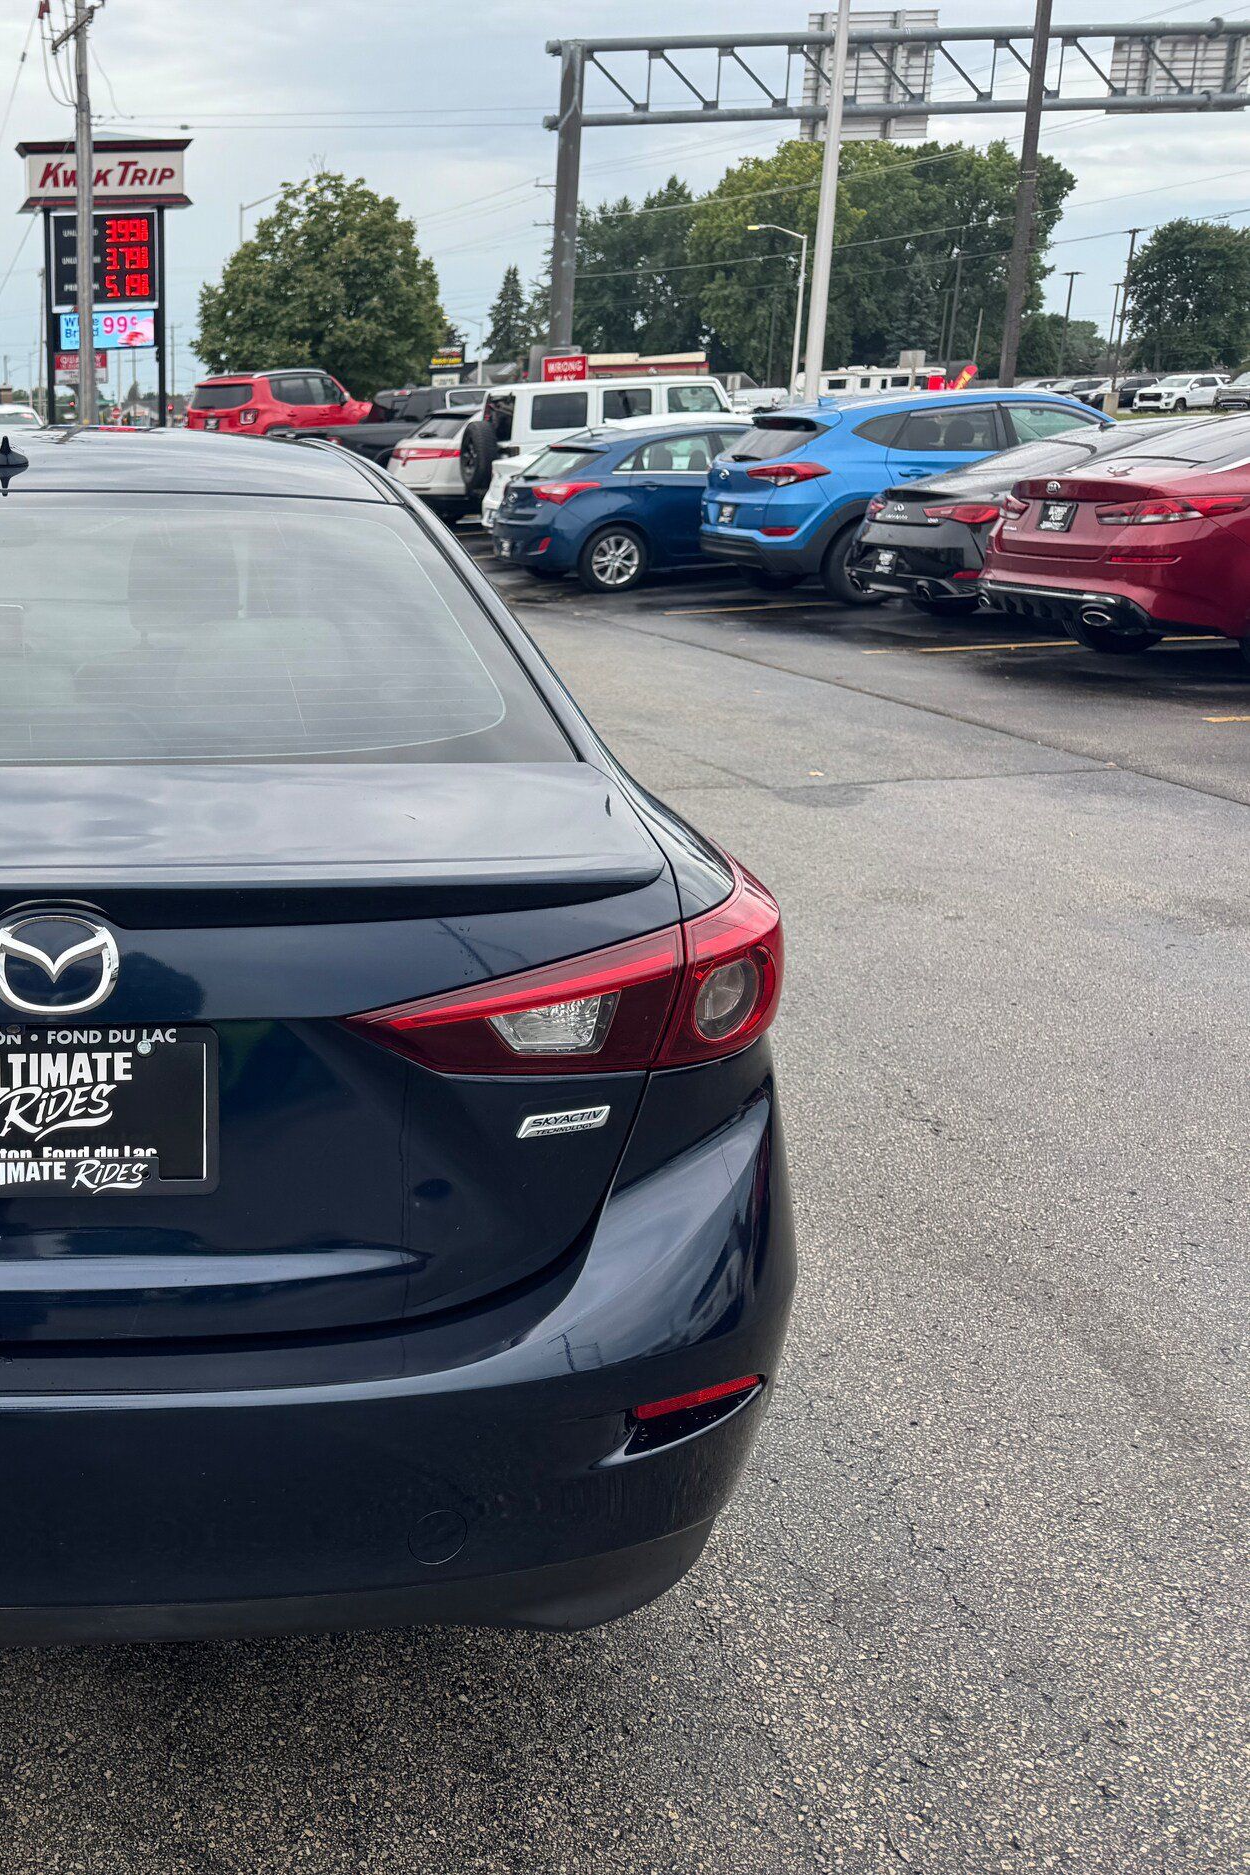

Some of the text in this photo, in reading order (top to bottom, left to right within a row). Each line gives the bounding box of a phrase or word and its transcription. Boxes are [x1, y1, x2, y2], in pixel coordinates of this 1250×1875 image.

[38, 161, 175, 188] KWK TRIP
[547, 360, 584, 373] WRONG
[46, 1030, 102, 1044] FOND
[108, 1029, 136, 1043] DU
[142, 1028, 177, 1044] LAC
[530, 1109, 606, 1127] SKYACTIV
[535, 1123, 594, 1135] TECHNOLOGY
